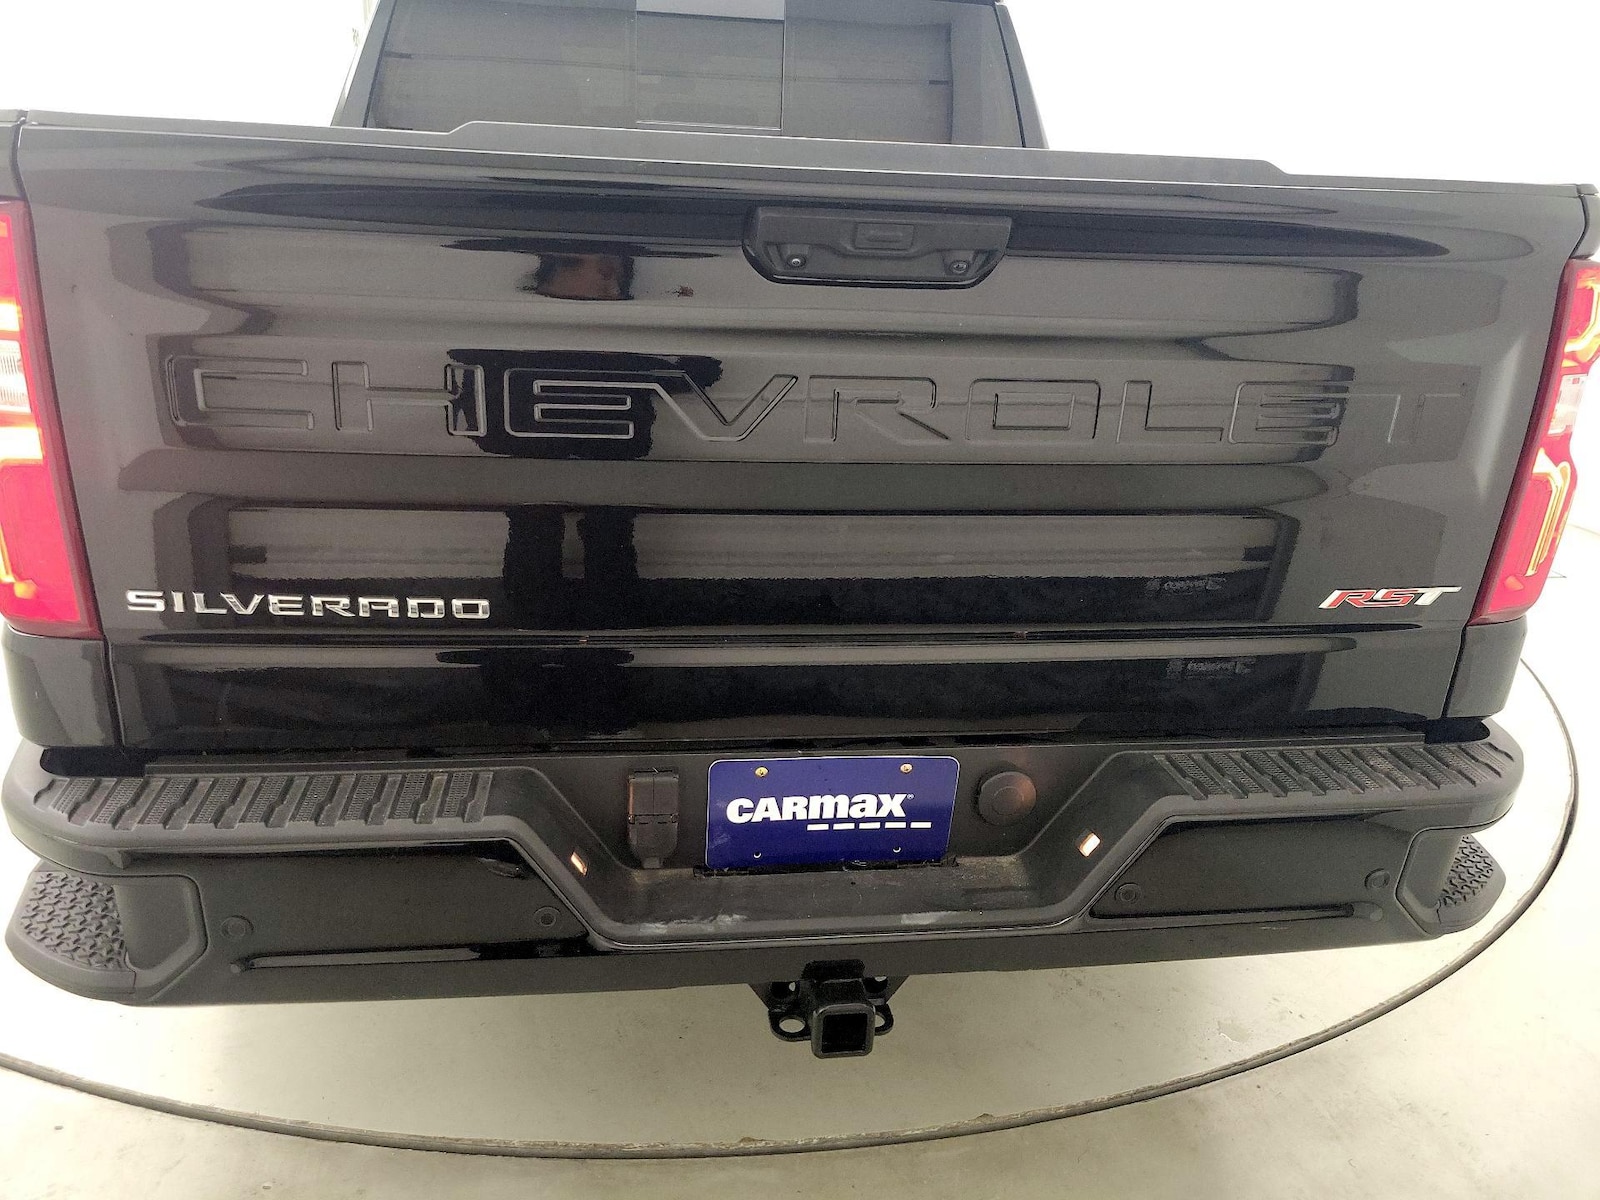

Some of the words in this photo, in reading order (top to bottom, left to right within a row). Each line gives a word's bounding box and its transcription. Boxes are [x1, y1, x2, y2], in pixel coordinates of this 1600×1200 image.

[166, 358, 1466, 447] CHEVROLET
[126, 589, 491, 620] SILVERADO
[1319, 586, 1462, 610] RST
